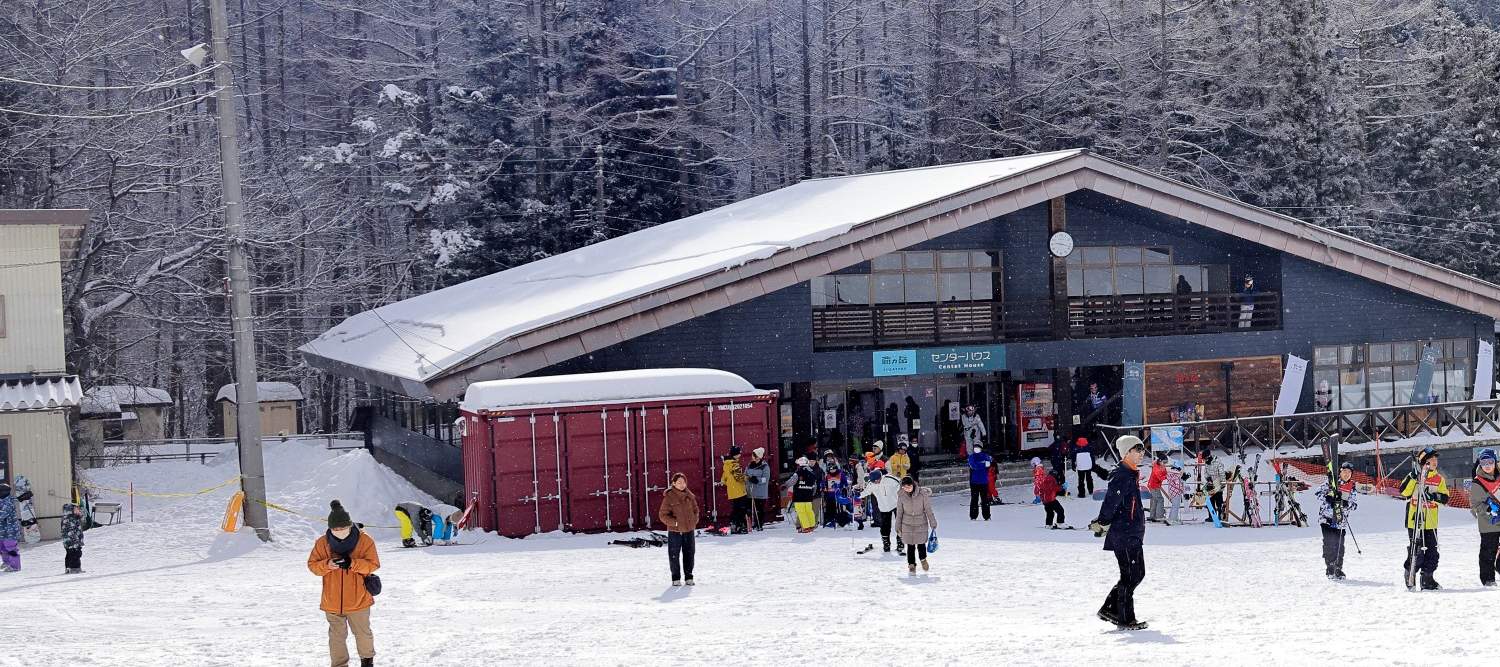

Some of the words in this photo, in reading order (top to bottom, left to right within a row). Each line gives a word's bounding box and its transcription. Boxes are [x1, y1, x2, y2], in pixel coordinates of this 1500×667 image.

[931, 351, 991, 363] センターハウス
